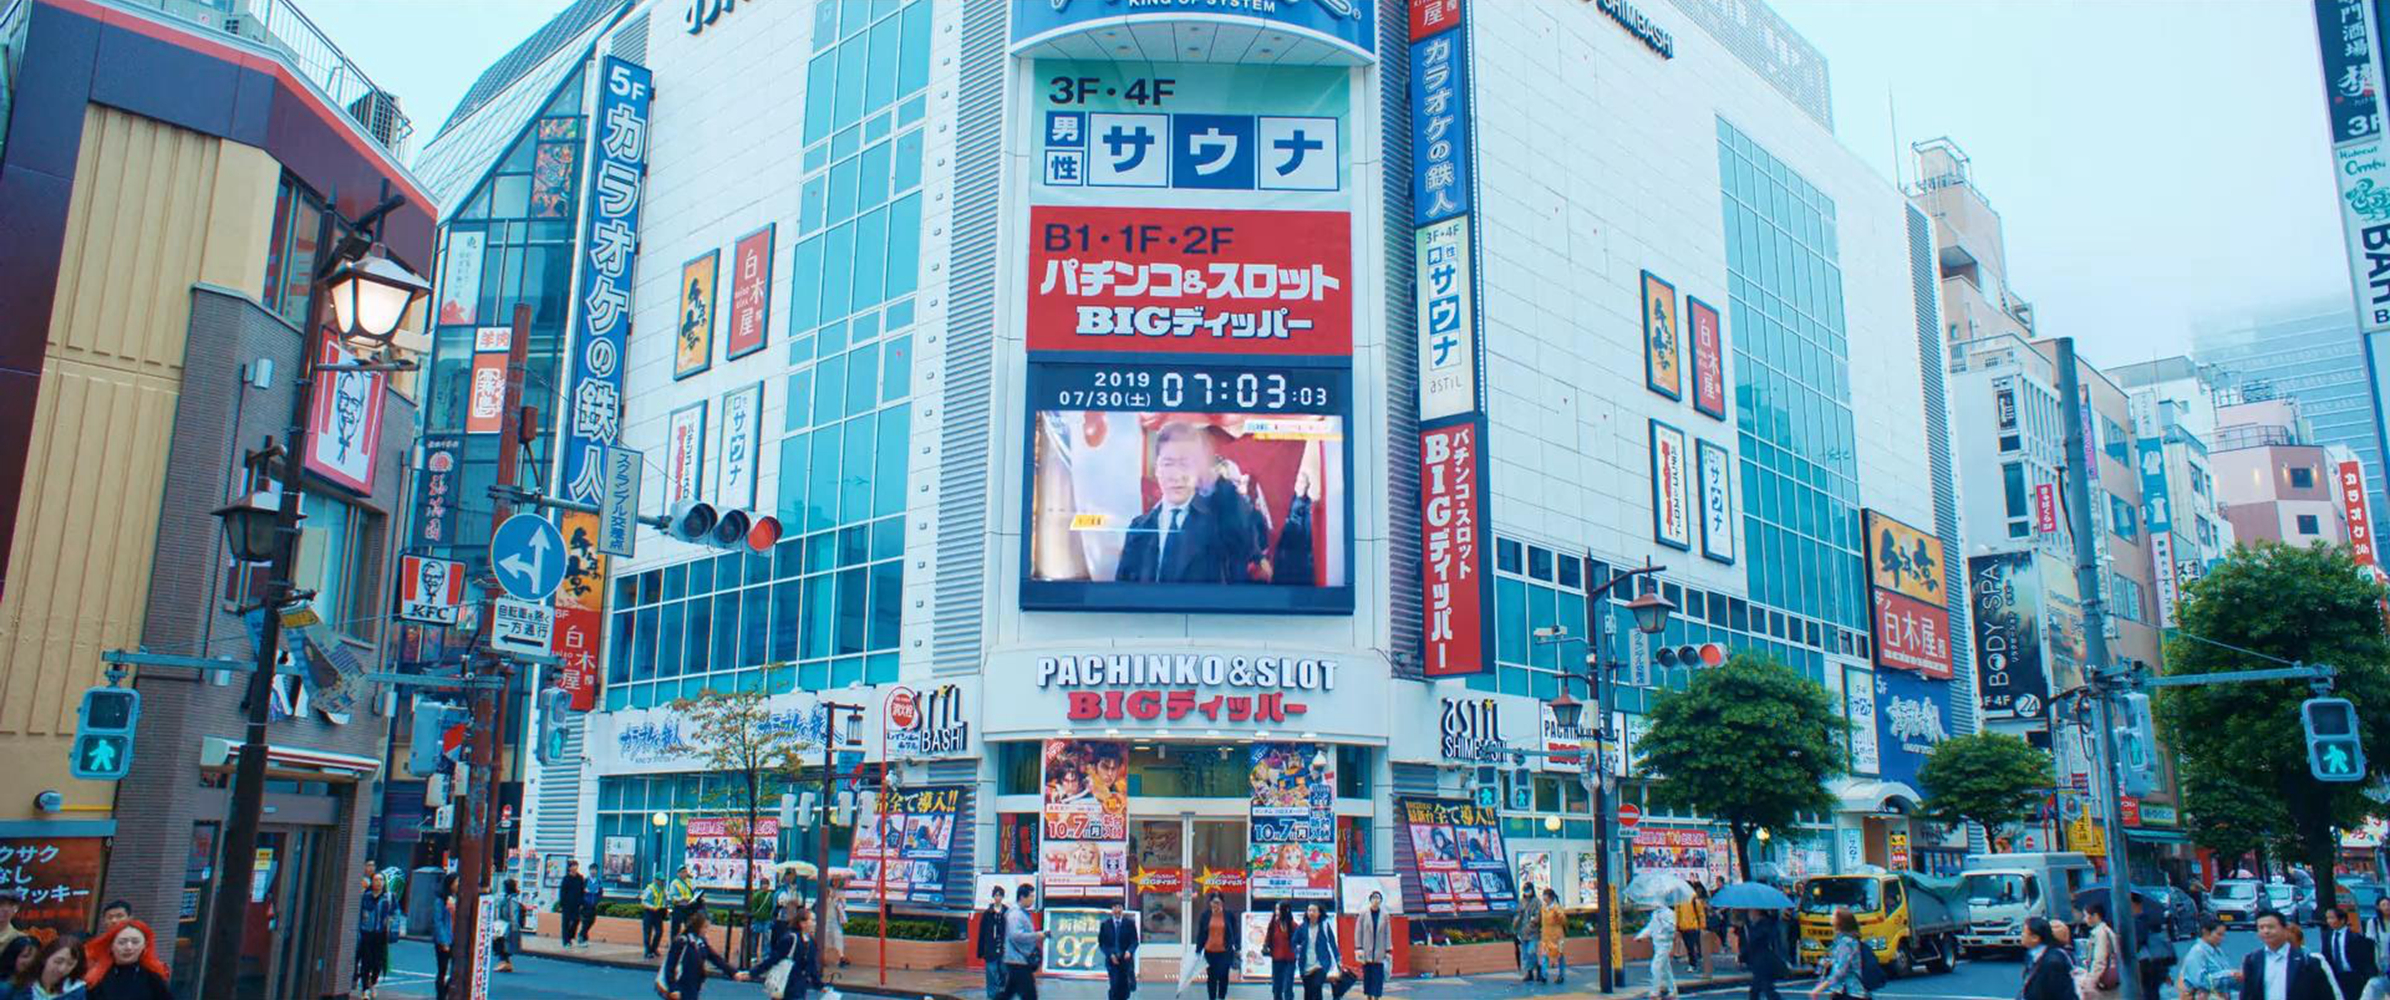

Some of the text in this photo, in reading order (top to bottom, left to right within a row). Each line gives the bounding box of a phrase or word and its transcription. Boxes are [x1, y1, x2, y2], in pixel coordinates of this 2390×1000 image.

[2337, 0, 2368, 57] 門酒場
[609, 65, 646, 100] 5F
[1050, 116, 1080, 181] 男性
[1422, 38, 1456, 217] カラオケの鉄人
[1102, 125, 1324, 177] サウナ
[568, 102, 646, 506] カラオケの鉄人
[739, 249, 765, 336] 白木屋
[1075, 305, 1313, 338] BIGディッパー
[1430, 266, 1459, 367] サウナ
[1059, 390, 1151, 408] 07/30(土)
[1094, 372, 1150, 387] 2019
[1425, 433, 1452, 669] BIGディッパー
[411, 604, 449, 620] KFC
[497, 621, 549, 639] 一方通行
[498, 605, 551, 624] 自転車を除く
[1883, 599, 1940, 658] 白木屋
[560, 625, 596, 690] 白木屋
[1036, 654, 1338, 690] PACHINKO&SLOT
[1984, 622, 2009, 686] BODY
[1066, 690, 1308, 723] BIGディッパー
[1443, 734, 1508, 761] SHIMBSHI
[1056, 934, 1100, 968] 97
